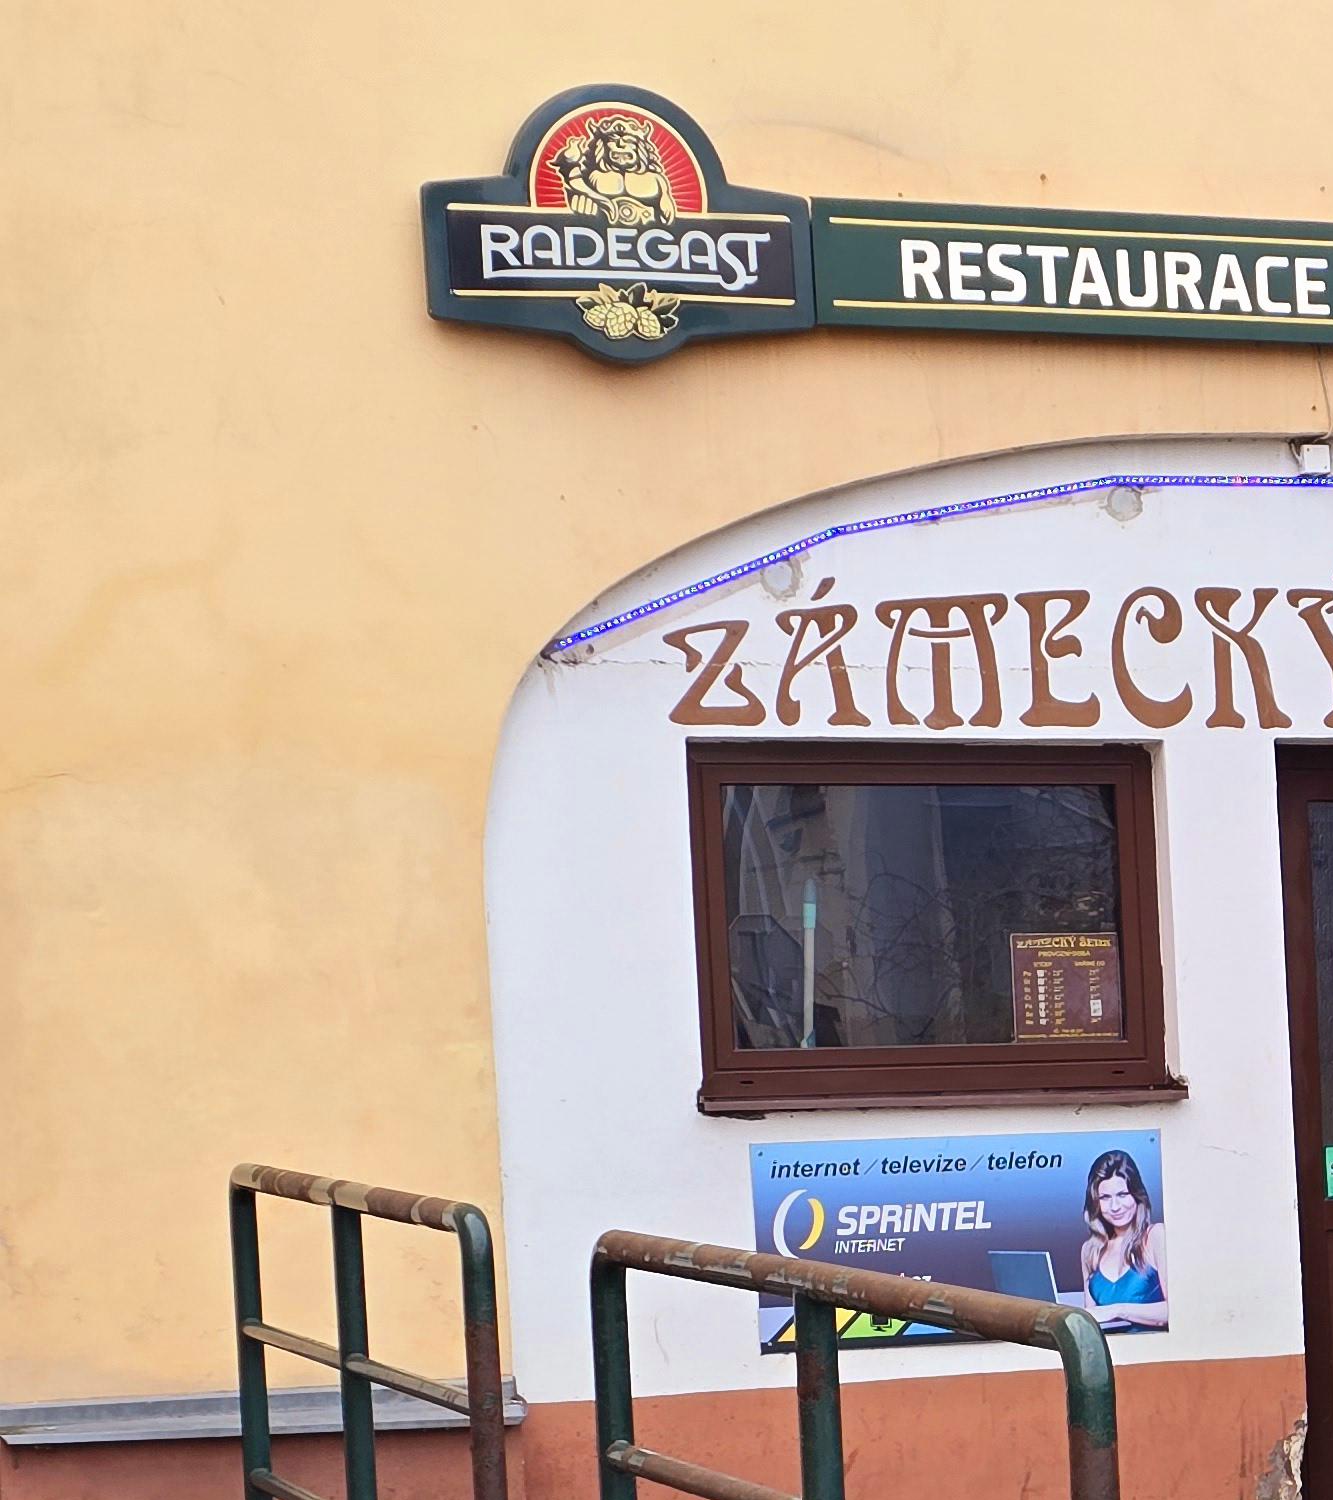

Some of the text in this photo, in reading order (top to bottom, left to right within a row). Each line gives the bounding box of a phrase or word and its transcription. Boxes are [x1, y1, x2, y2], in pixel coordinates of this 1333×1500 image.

[480, 223, 771, 291] RADEGAST
[900, 239, 1331, 316] RESTAURACE
[770, 1157, 860, 1179] internet
[881, 1154, 967, 1176] televize
[987, 1150, 1063, 1171] telefon
[834, 1237, 906, 1254] INTERNET
